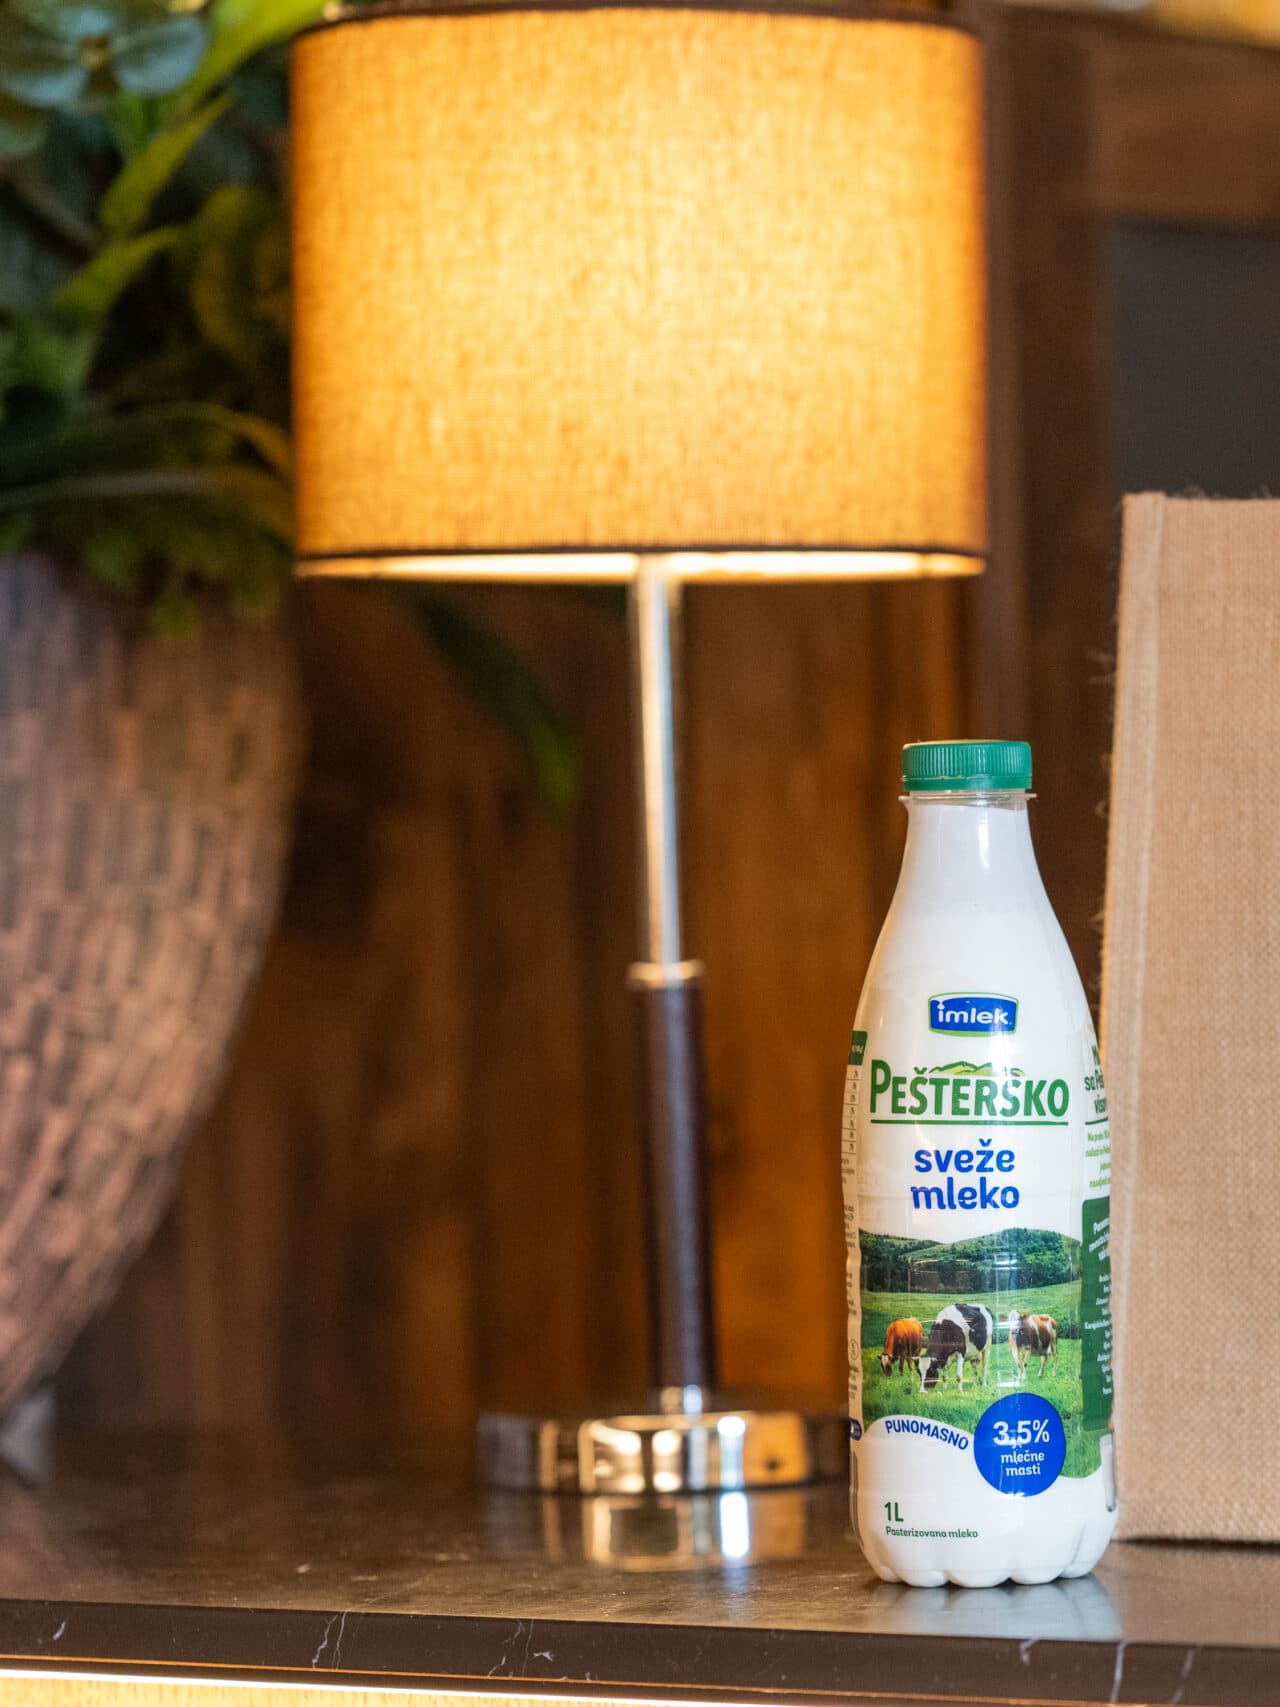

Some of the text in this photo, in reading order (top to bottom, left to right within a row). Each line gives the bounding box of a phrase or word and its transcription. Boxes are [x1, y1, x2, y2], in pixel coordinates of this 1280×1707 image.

[937, 1004, 1009, 1025] imlek
[870, 1059, 1070, 1118] PEŠTERSKO
[914, 1138, 1016, 1174] sveže
[911, 1176, 1020, 1210] mleko
[885, 1418, 970, 1451] PUNOMASNO
[1000, 1448, 1045, 1464] mlečne
[1005, 1462, 1041, 1477] masti
[884, 1501, 904, 1522] 1L
[885, 1525, 979, 1539] Pasterizovano mleko
